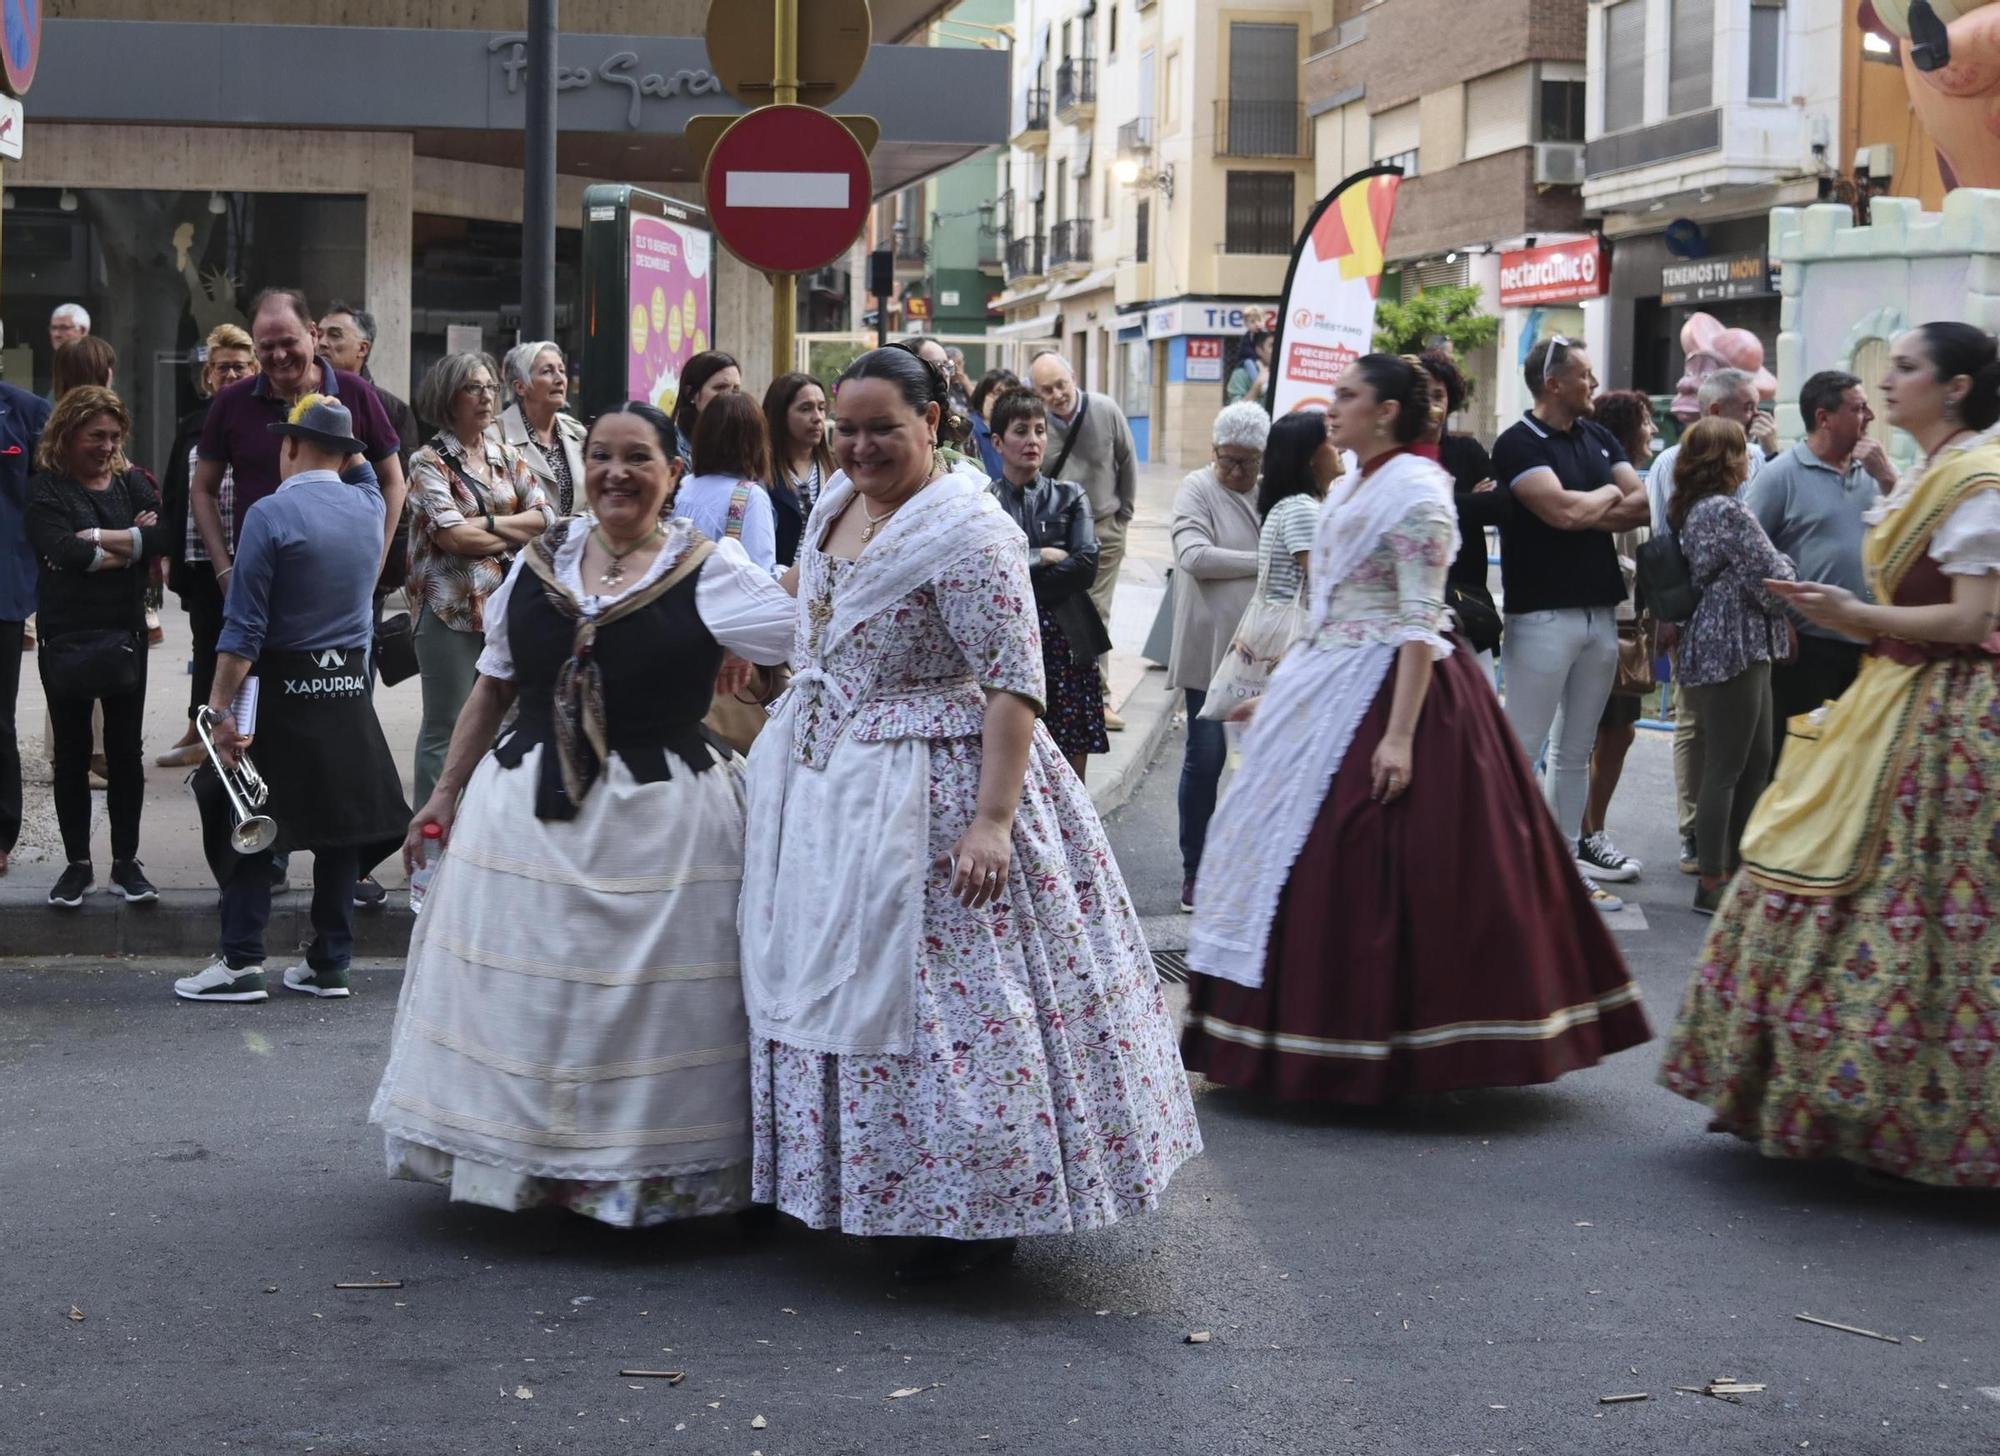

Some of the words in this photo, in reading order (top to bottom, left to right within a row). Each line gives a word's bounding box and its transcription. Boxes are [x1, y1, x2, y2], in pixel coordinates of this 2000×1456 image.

[488, 36, 592, 93] Pco
[1662, 262, 1714, 287] TENEMOS
[1714, 261, 1729, 281] TU
[1205, 308, 1243, 328] Tie
[1189, 341, 1219, 357] T21
